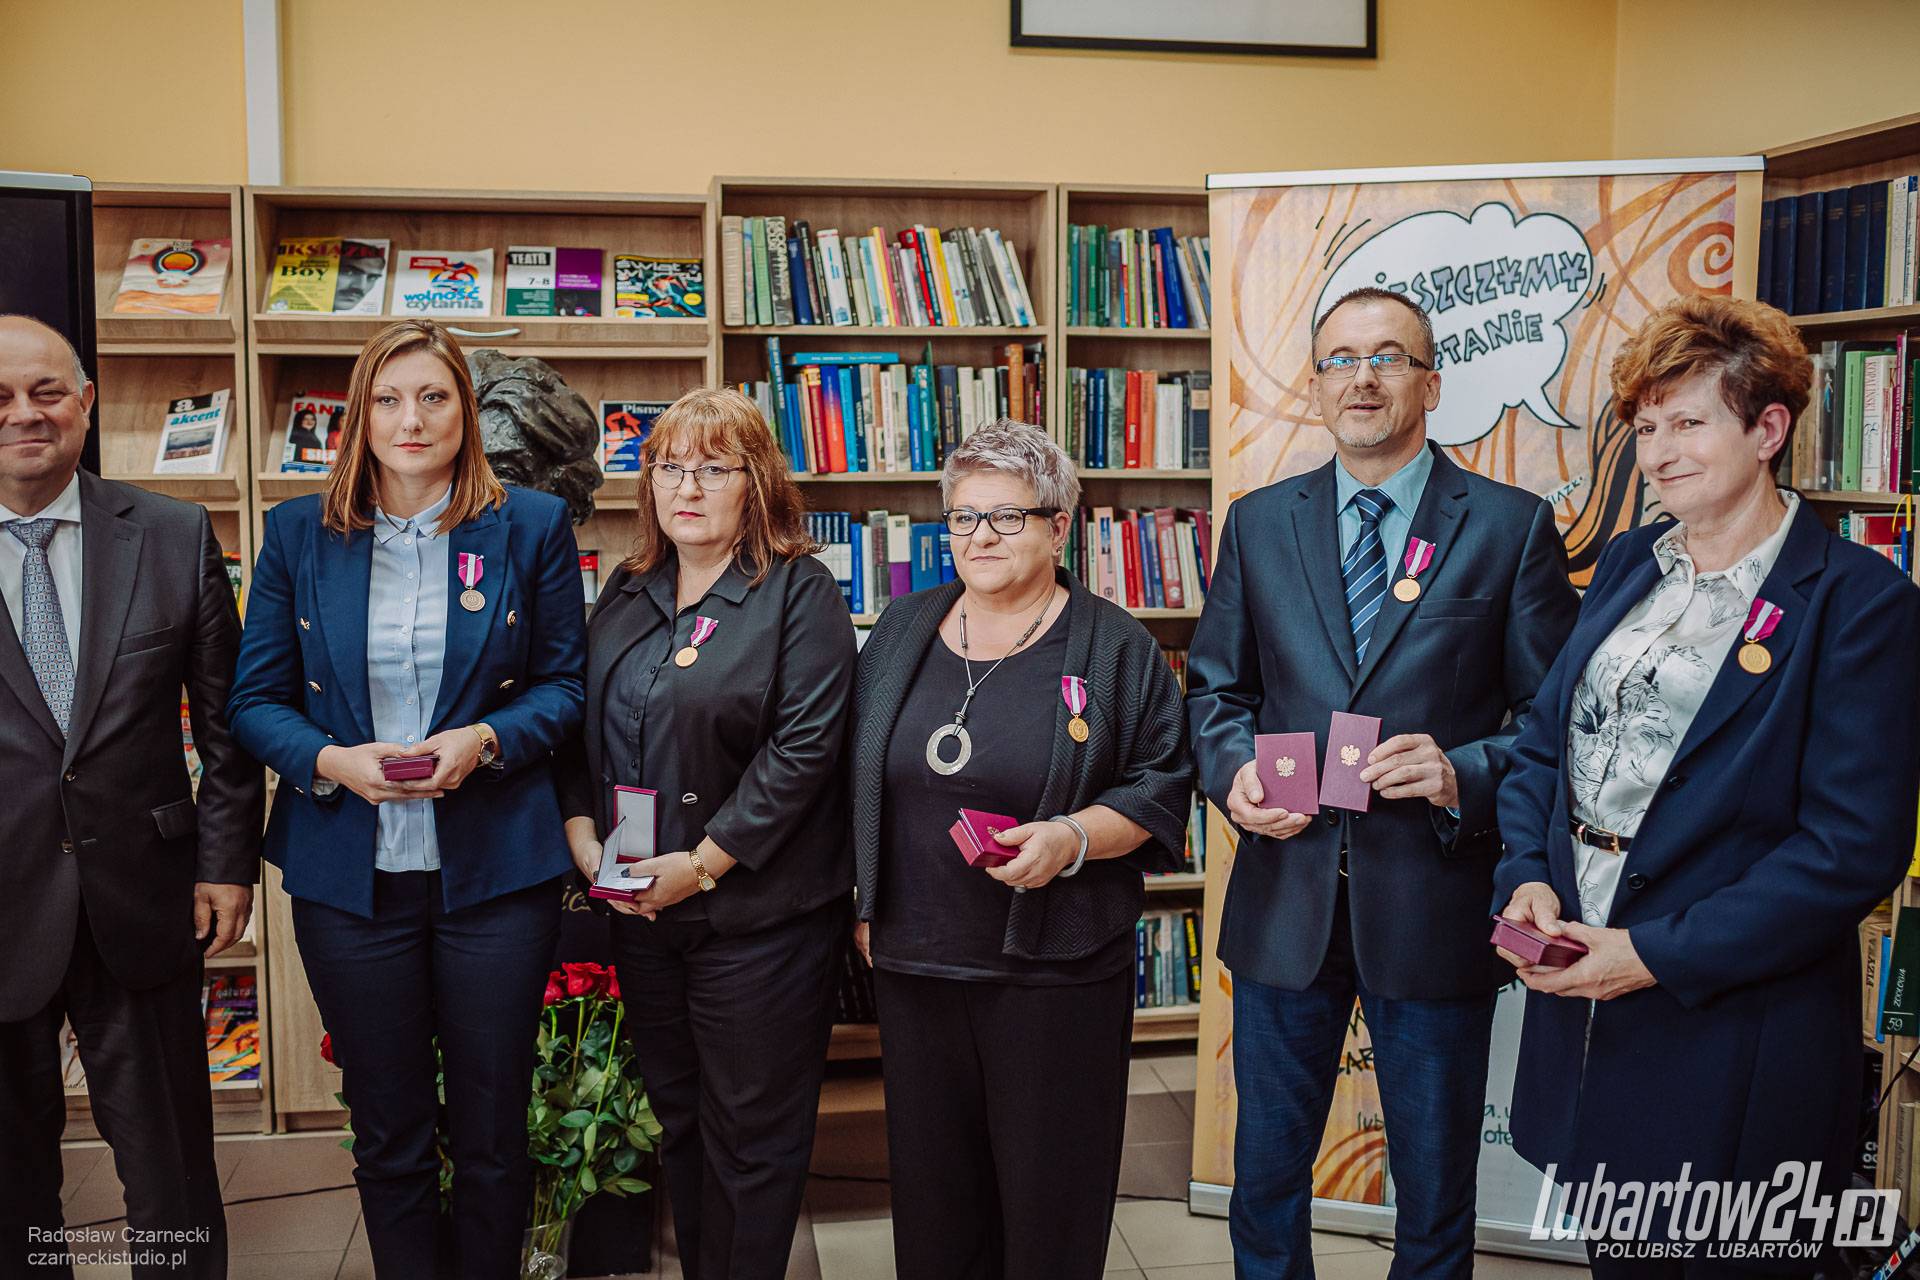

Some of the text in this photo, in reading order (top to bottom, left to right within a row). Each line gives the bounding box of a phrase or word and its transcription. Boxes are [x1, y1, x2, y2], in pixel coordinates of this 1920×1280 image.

[510, 253, 548, 266] TEATR
[281, 265, 329, 281] Boy
[404, 286, 480, 302] wolność
[406, 299, 484, 312] czytania
[622, 403, 666, 415] Pismo
[170, 408, 221, 426] akcent
